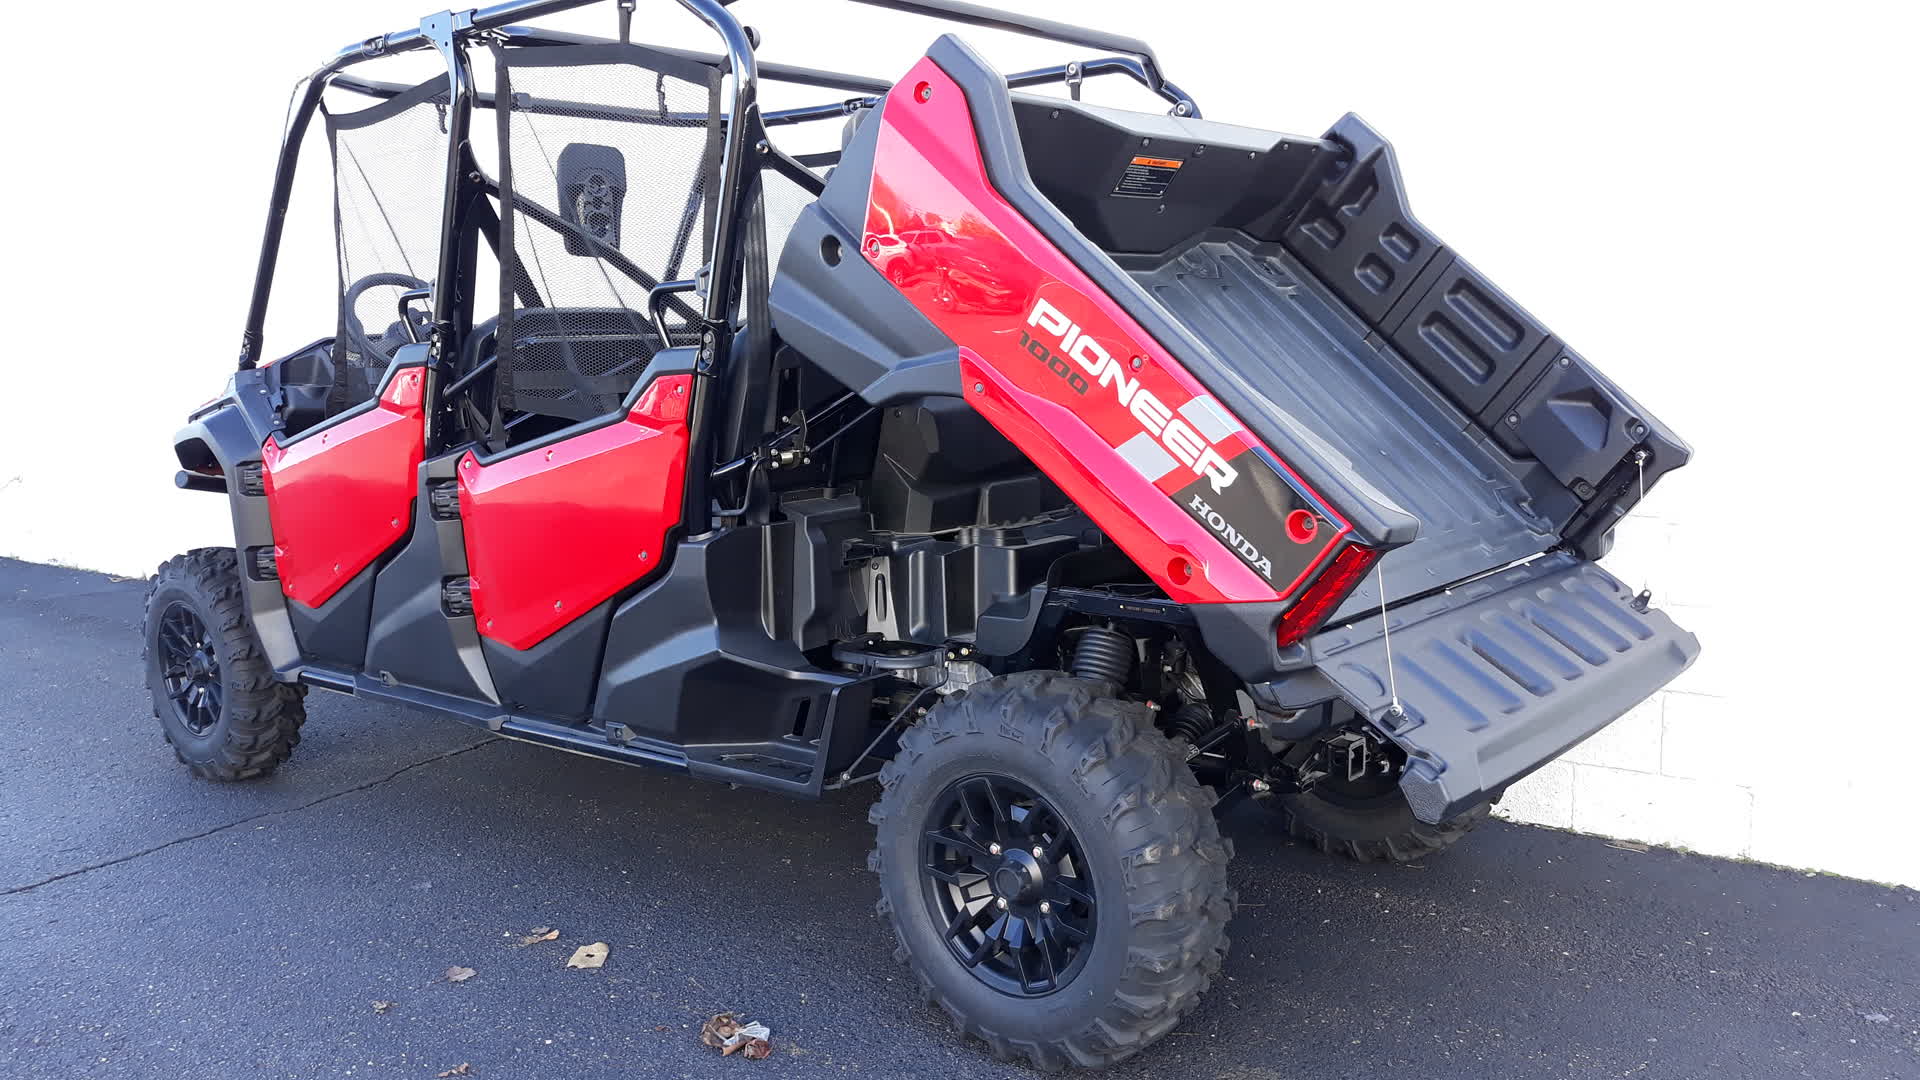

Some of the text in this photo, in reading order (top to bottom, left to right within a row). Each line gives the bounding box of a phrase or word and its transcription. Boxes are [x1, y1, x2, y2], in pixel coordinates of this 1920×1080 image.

[1020, 330, 1089, 395] 1000
[1027, 297, 1239, 495] PIONEER
[1188, 494, 1272, 579] HONDA
